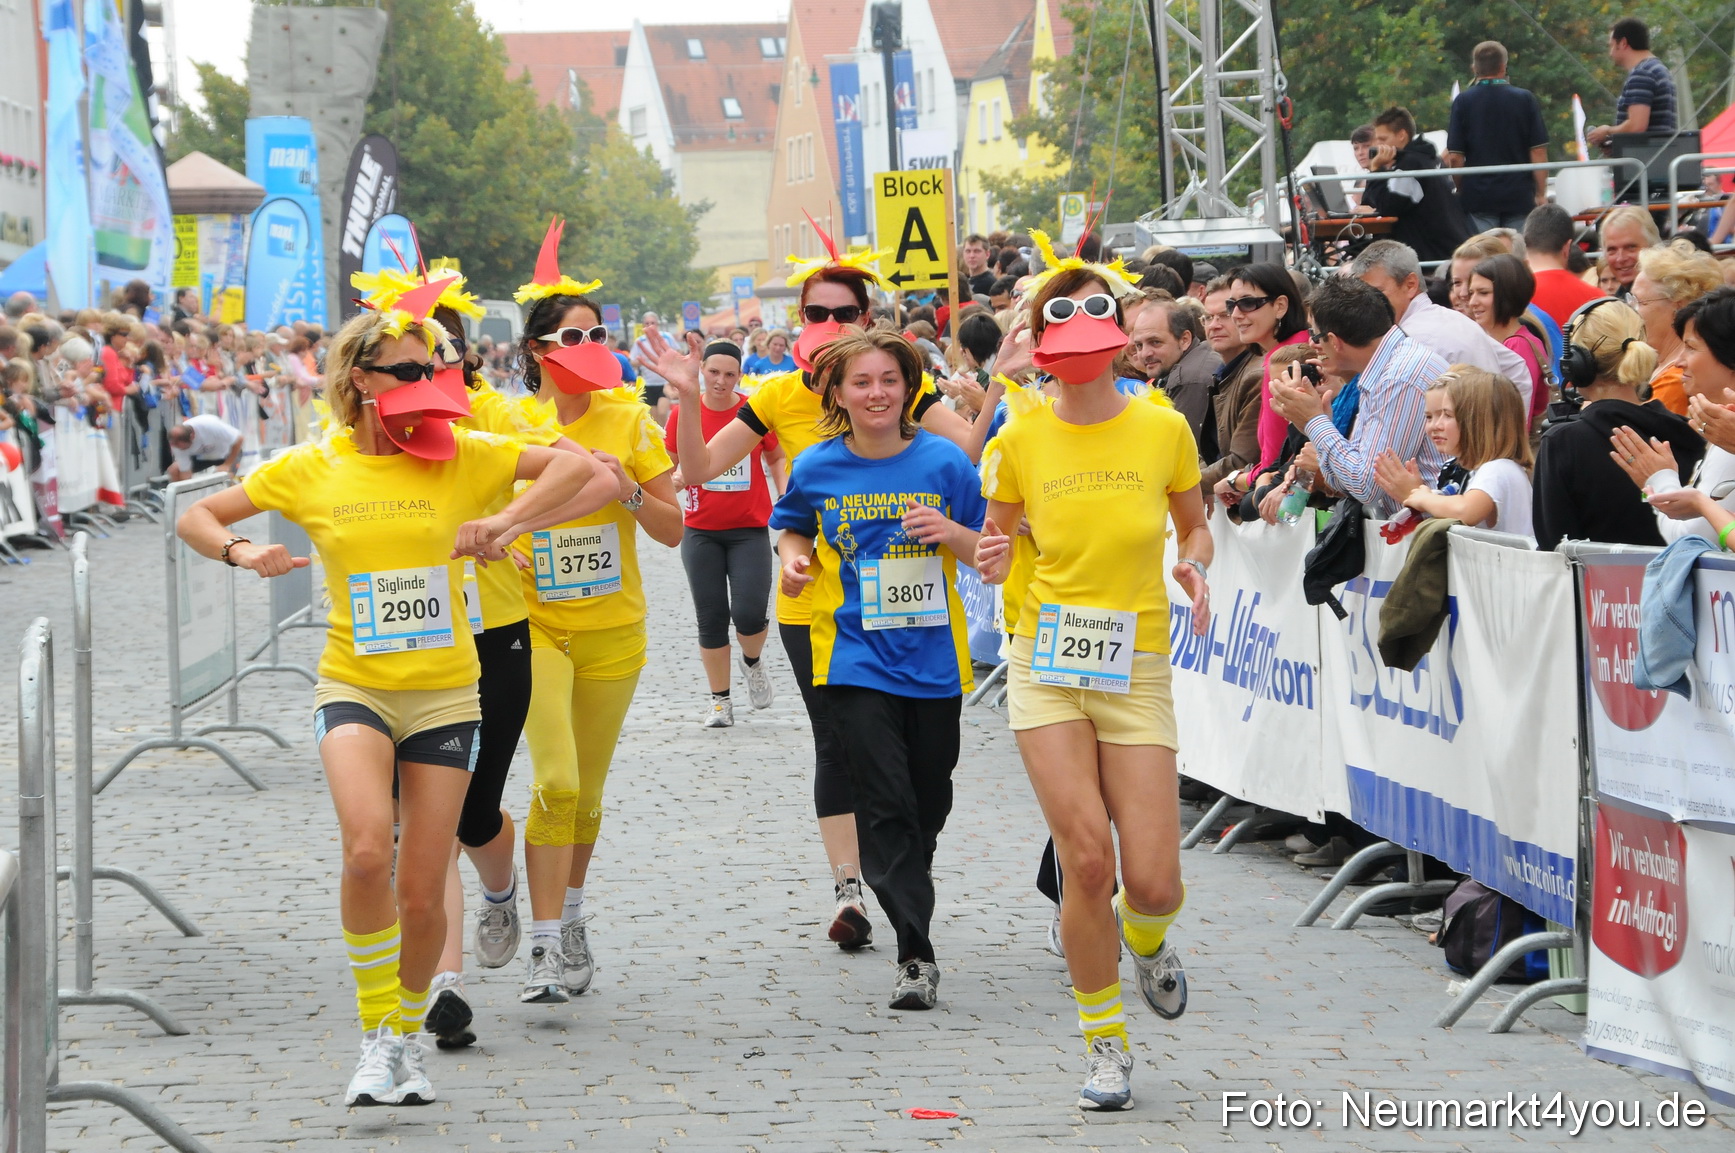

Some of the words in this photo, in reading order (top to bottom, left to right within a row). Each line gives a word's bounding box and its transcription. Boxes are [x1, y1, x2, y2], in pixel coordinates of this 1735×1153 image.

[908, 155, 948, 170] swn
[883, 175, 944, 197] Block
[342, 153, 383, 259] THULE
[895, 207, 939, 263] A
[1043, 471, 1143, 494] BRIGITTEKARL
[333, 499, 435, 518] BRIGITTEKARL
[824, 497, 839, 511] 10.
[842, 493, 942, 509] NEUMARKTER
[840, 505, 912, 521] STADTLA
[557, 535, 601, 548] Johanna
[560, 551, 612, 574] 3752
[377, 575, 425, 595] Siglinde
[591, 580, 621, 592] PFLEIDERER
[887, 583, 935, 604] 3807
[382, 597, 440, 623] 2900
[916, 614, 947, 622] PFLEIDERER
[1590, 588, 1609, 628] Wir
[1064, 612, 1124, 633] Alexandra
[417, 634, 452, 645] PFLEIDERER
[1061, 636, 1122, 662] 2917
[1597, 644, 1611, 682] im
[1091, 677, 1128, 688] PFLEIDERER
[439, 744, 463, 752] adidas
[1609, 828, 1630, 871] Wir
[1632, 835, 1680, 886] verkaufen
[1608, 885, 1631, 926] im
[1632, 889, 1678, 952] Auftrag!
